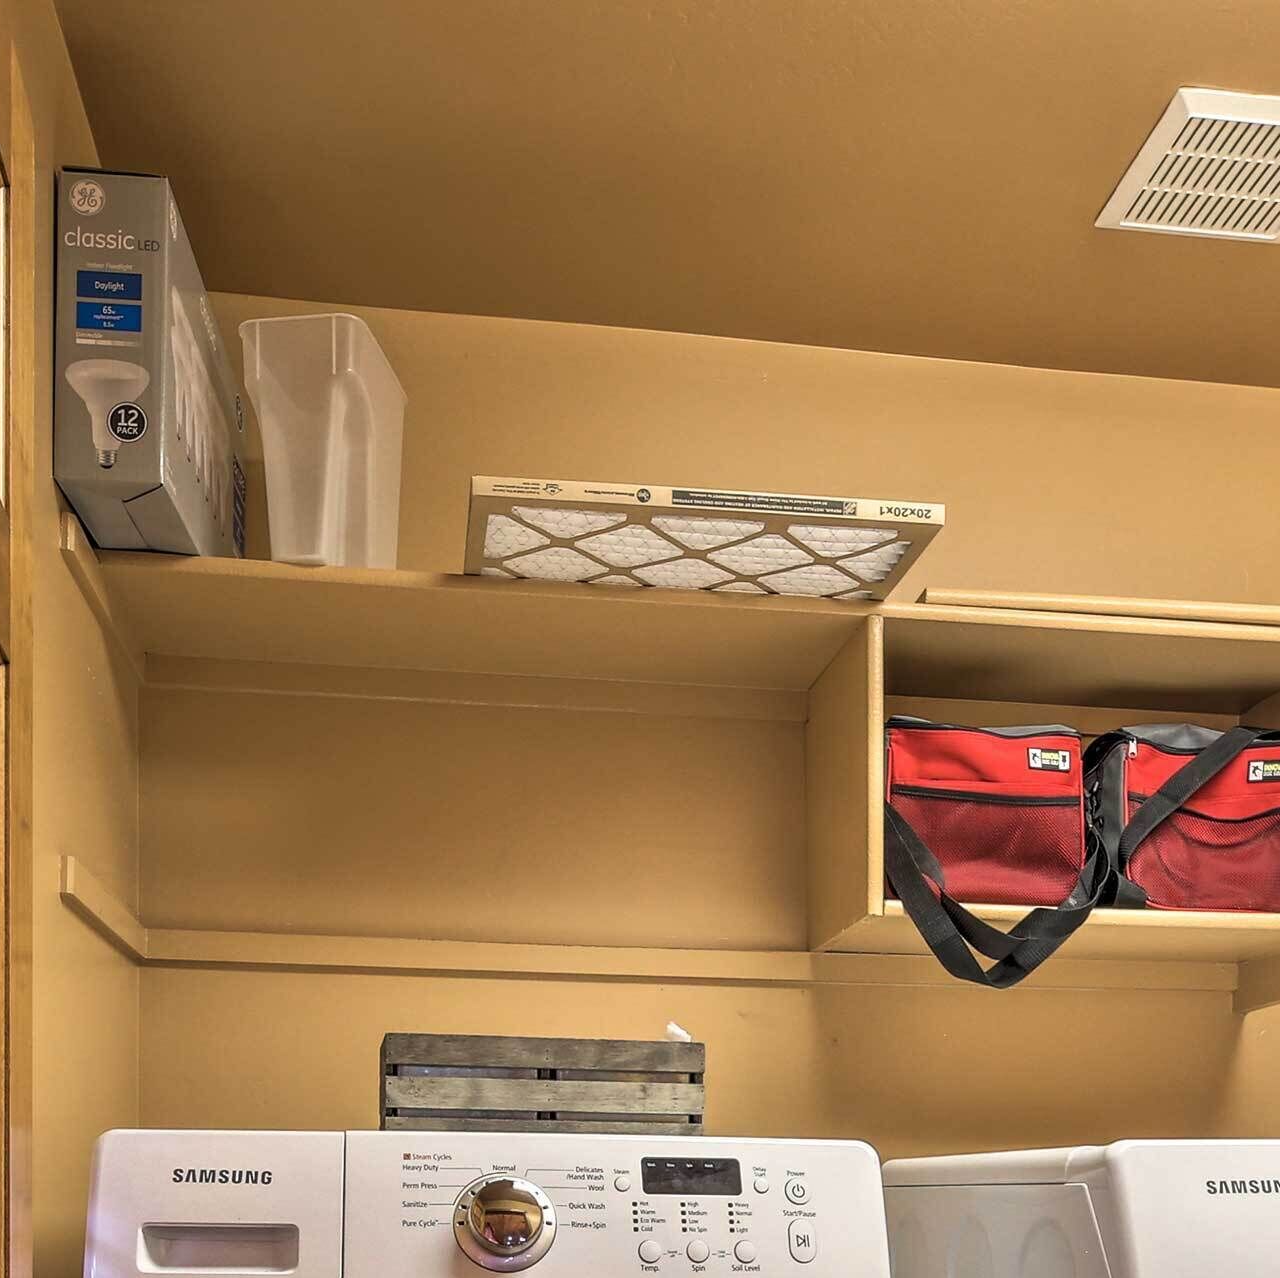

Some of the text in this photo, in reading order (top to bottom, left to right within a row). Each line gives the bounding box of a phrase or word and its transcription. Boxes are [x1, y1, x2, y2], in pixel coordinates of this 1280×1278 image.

[63, 225, 161, 252] classic LED
[94, 281, 125, 292] Daylight
[117, 409, 139, 427] 12
[116, 426, 139, 435] PACK
[879, 506, 932, 519] 20x20x1
[432, 1153, 452, 1161] Cycles
[402, 1164, 439, 1172] Heavy Duty
[171, 1168, 273, 1185] SAMSUNG
[402, 1200, 428, 1208] Sanitize
[568, 1202, 587, 1210] Quick
[731, 1264, 744, 1272] Soil
